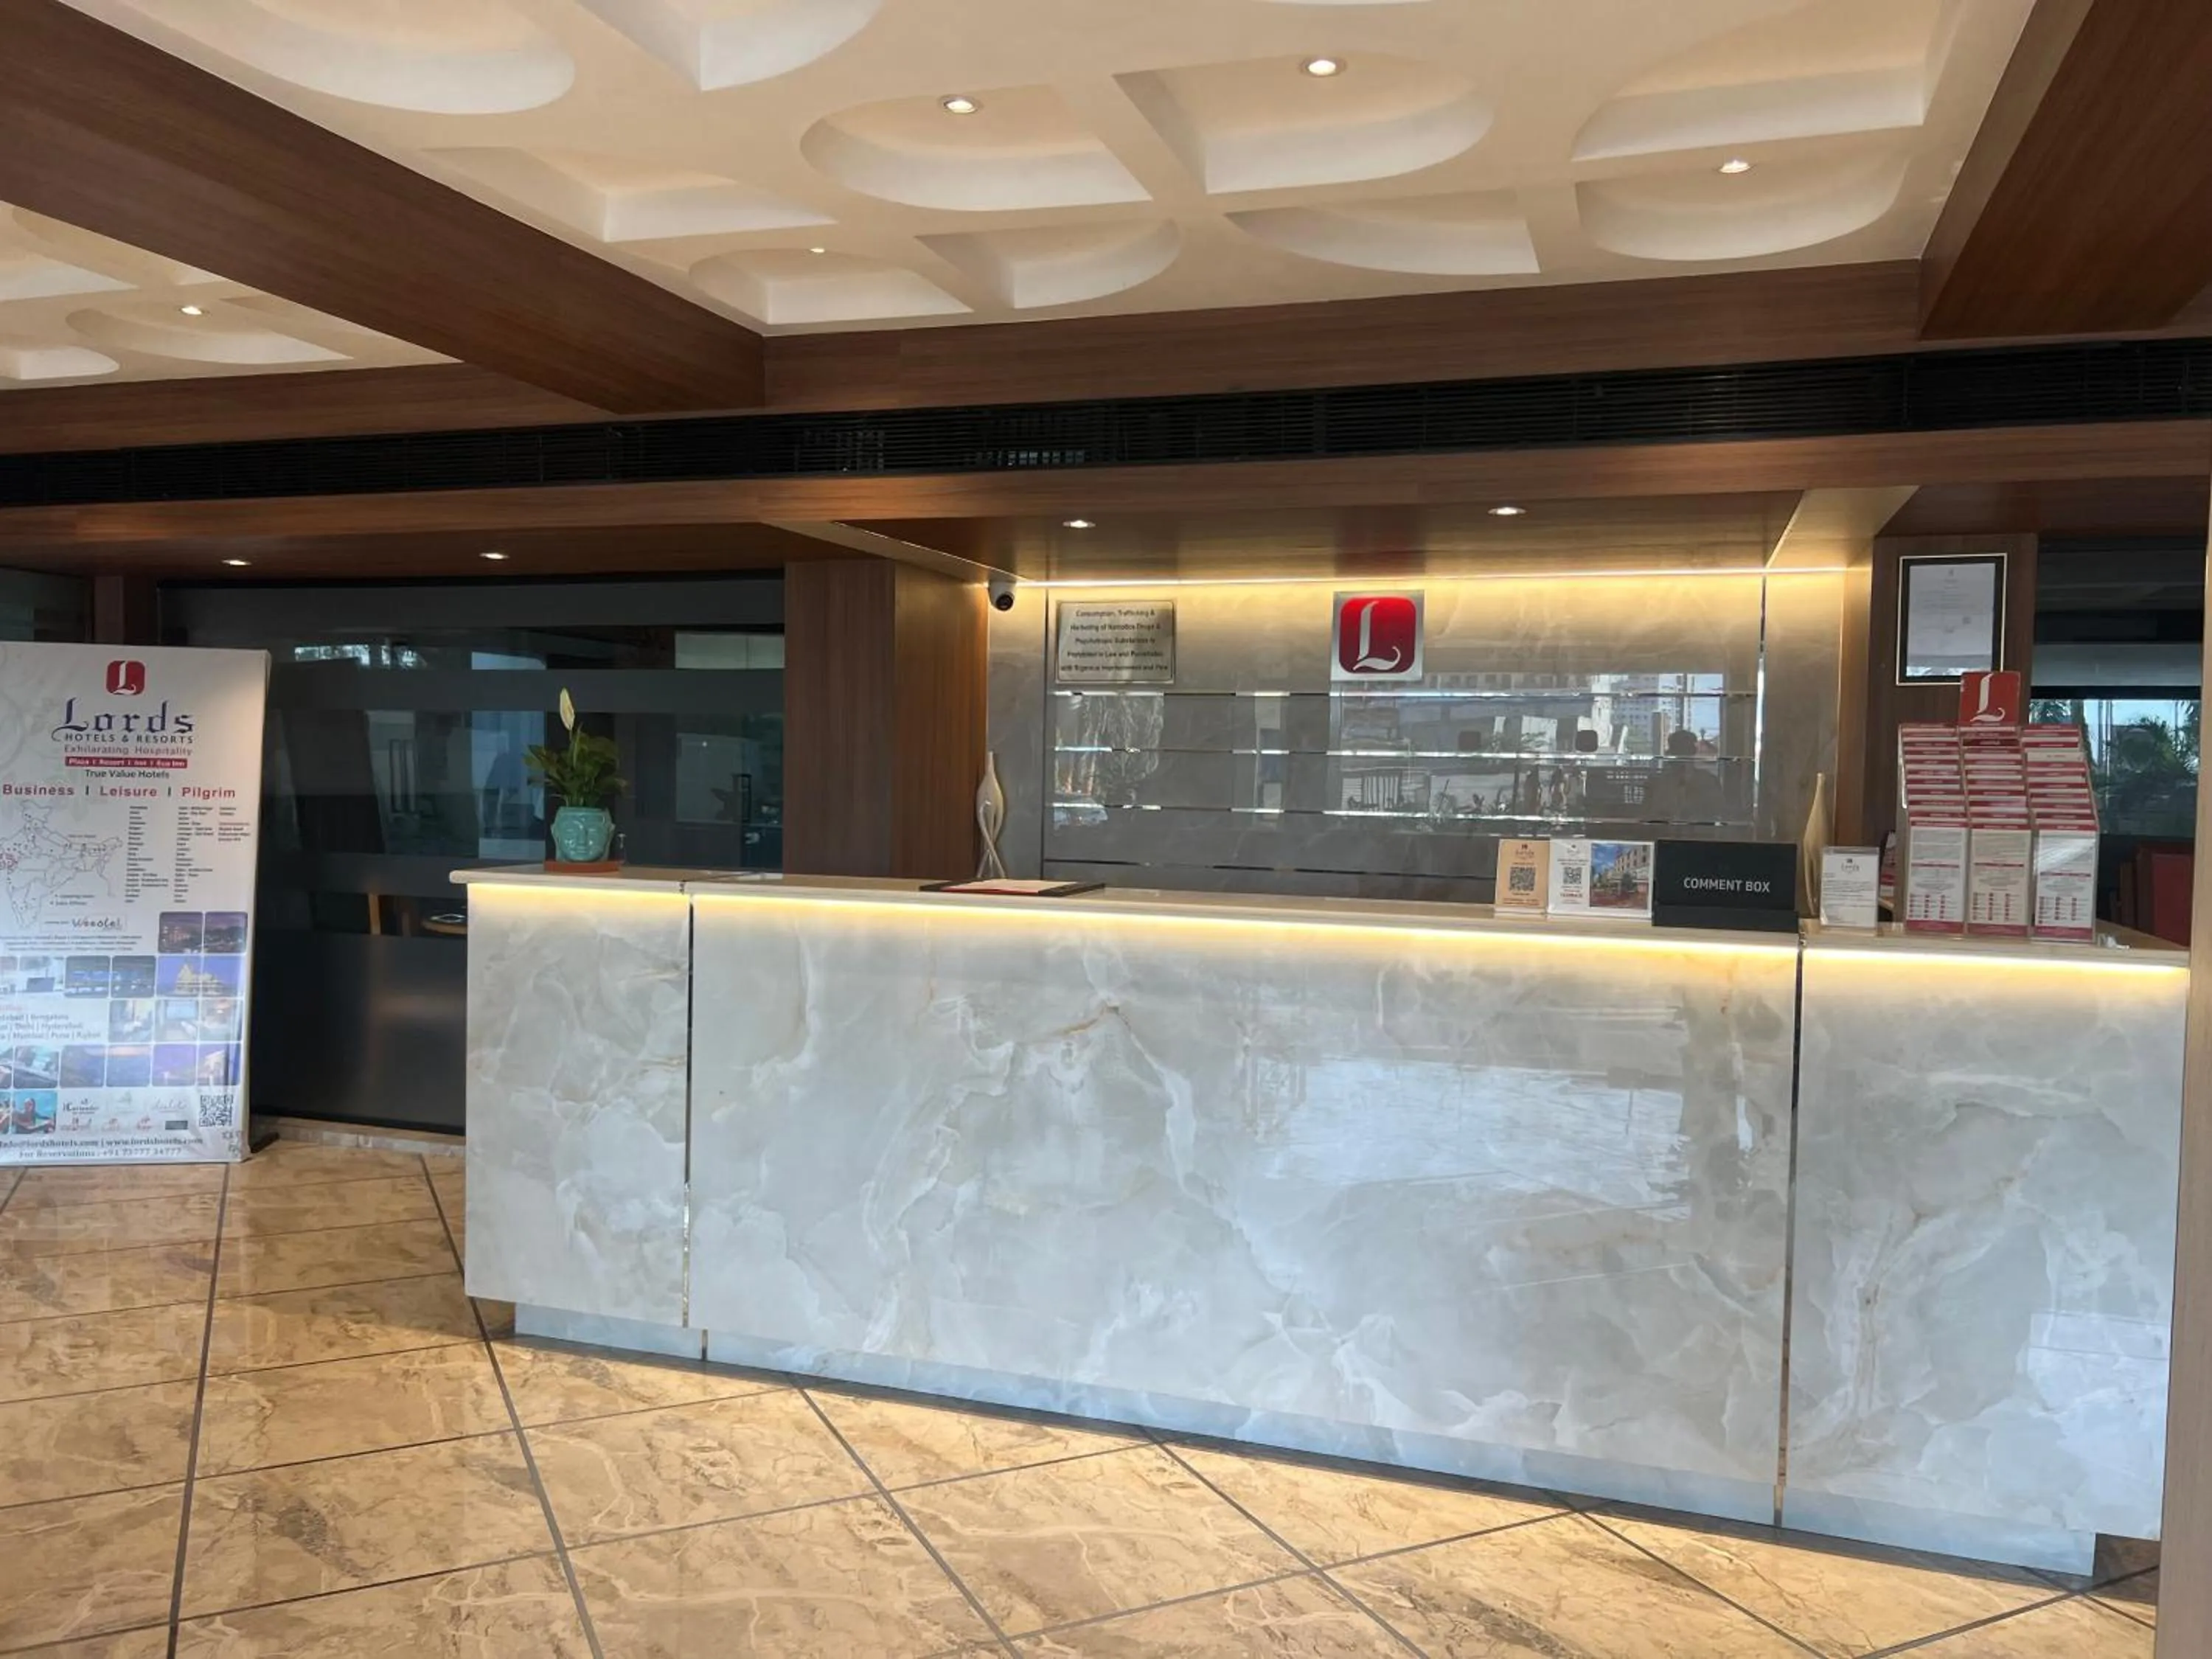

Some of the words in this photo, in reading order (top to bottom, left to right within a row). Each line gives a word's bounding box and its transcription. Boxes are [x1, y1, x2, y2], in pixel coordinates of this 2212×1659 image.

[1352, 599, 1402, 671] L
[1969, 672, 2006, 722] L
[52, 697, 195, 740] Lords
[65, 733, 115, 742] HOTELS
[122, 734, 130, 742] &
[136, 734, 194, 744] RESORTS
[64, 745, 129, 756] Exhilarating
[135, 745, 193, 757] Hospitality
[85, 769, 107, 778] True
[108, 769, 136, 779] Value
[138, 770, 170, 779] Hotels
[2, 784, 74, 796] Business
[100, 785, 157, 797] Leisure
[181, 787, 236, 800] Pilgrim
[1683, 877, 1743, 892] COMMENT
[1745, 880, 1770, 893] BOX
